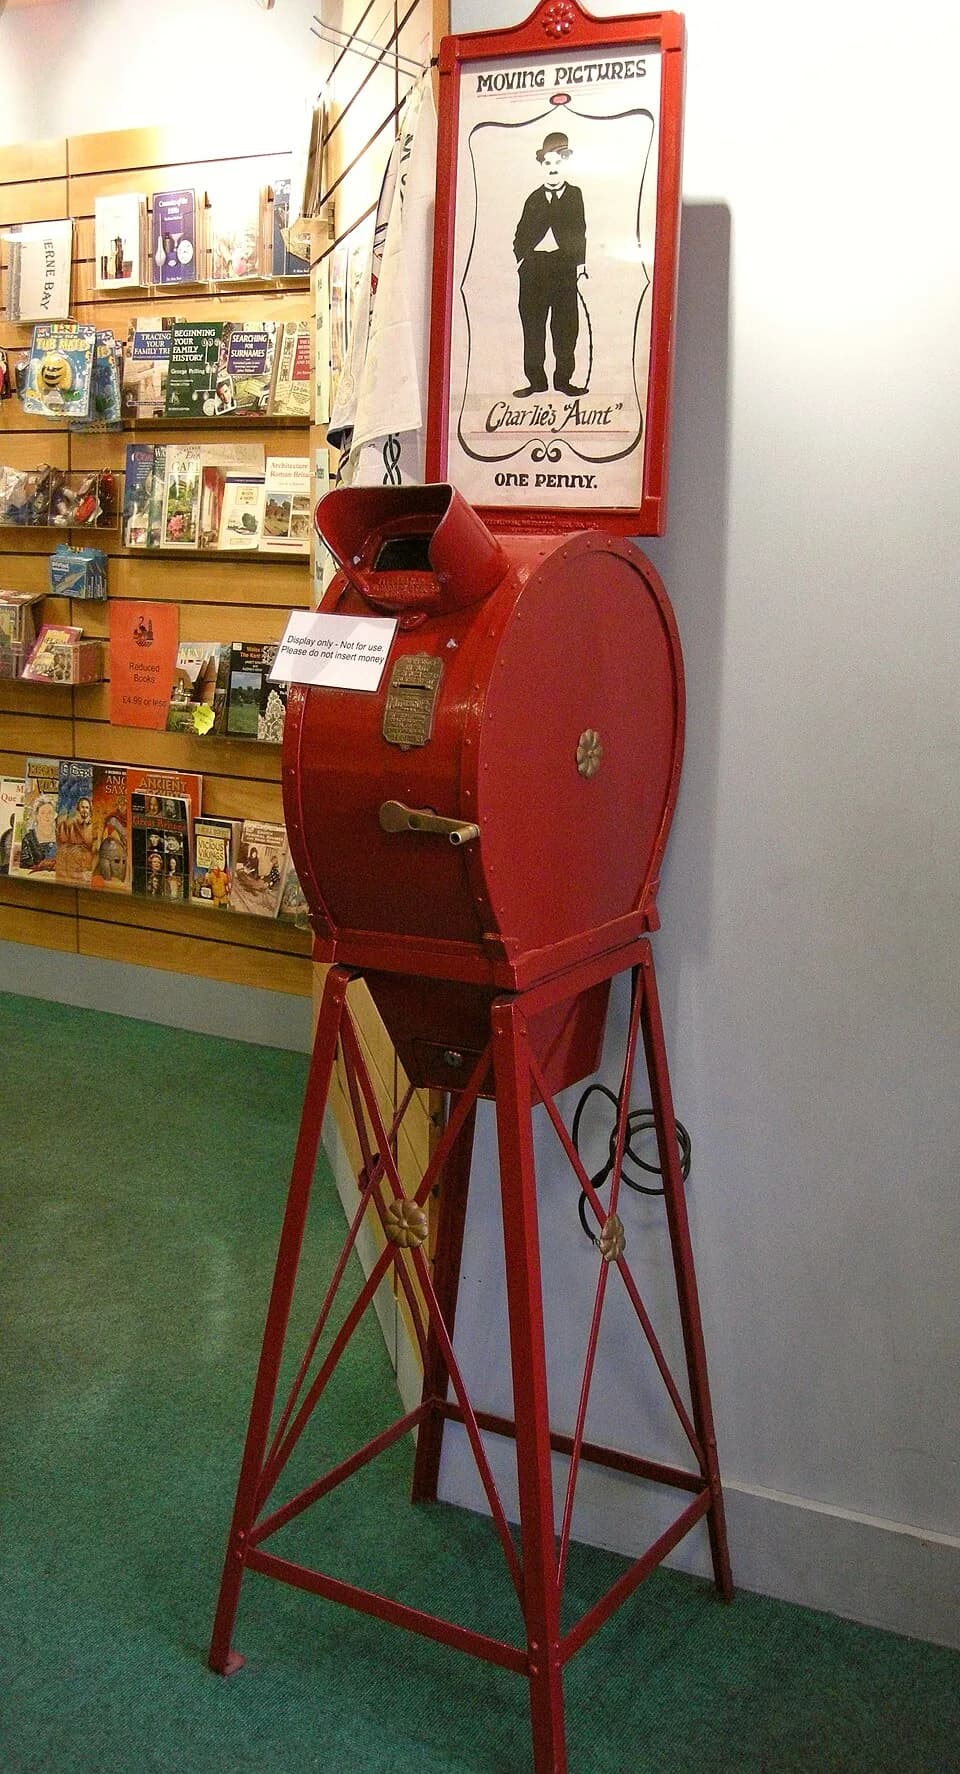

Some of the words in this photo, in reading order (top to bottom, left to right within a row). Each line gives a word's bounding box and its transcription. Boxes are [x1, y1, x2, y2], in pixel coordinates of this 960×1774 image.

[476, 69, 545, 93] MOVING
[554, 59, 647, 86] PICTURES
[40, 282, 55, 310] BAY
[141, 333, 172, 341] TRACING
[174, 329, 216, 337] BEGINNING
[232, 334, 268, 343] SEARCHING
[134, 347, 158, 355] FAMILY
[172, 346, 199, 354] FAMILY
[231, 349, 266, 358] SURNAMES
[172, 354, 204, 362] HISTORY
[485, 401, 558, 433] Charlie's
[271, 462, 308, 470] Architecture
[494, 472, 529, 487] ONE
[534, 473, 598, 488] PENNY.
[287, 635, 315, 647] Display
[317, 639, 334, 649] only
[340, 641, 355, 650] Not
[355, 641, 367, 651] for
[367, 644, 384, 652] use.
[281, 645, 307, 656] Please
[309, 648, 318, 657] do
[320, 651, 334, 659] not
[334, 651, 357, 661] insert
[358, 655, 385, 664] money
[129, 663, 160, 673] Reduced
[134, 674, 156, 684] Books
[122, 696, 142, 705] £4.99
[139, 777, 187, 792] ANCIENT
[198, 840, 225, 852] VICIOUS
[198, 849, 224, 861] VIKINGS
